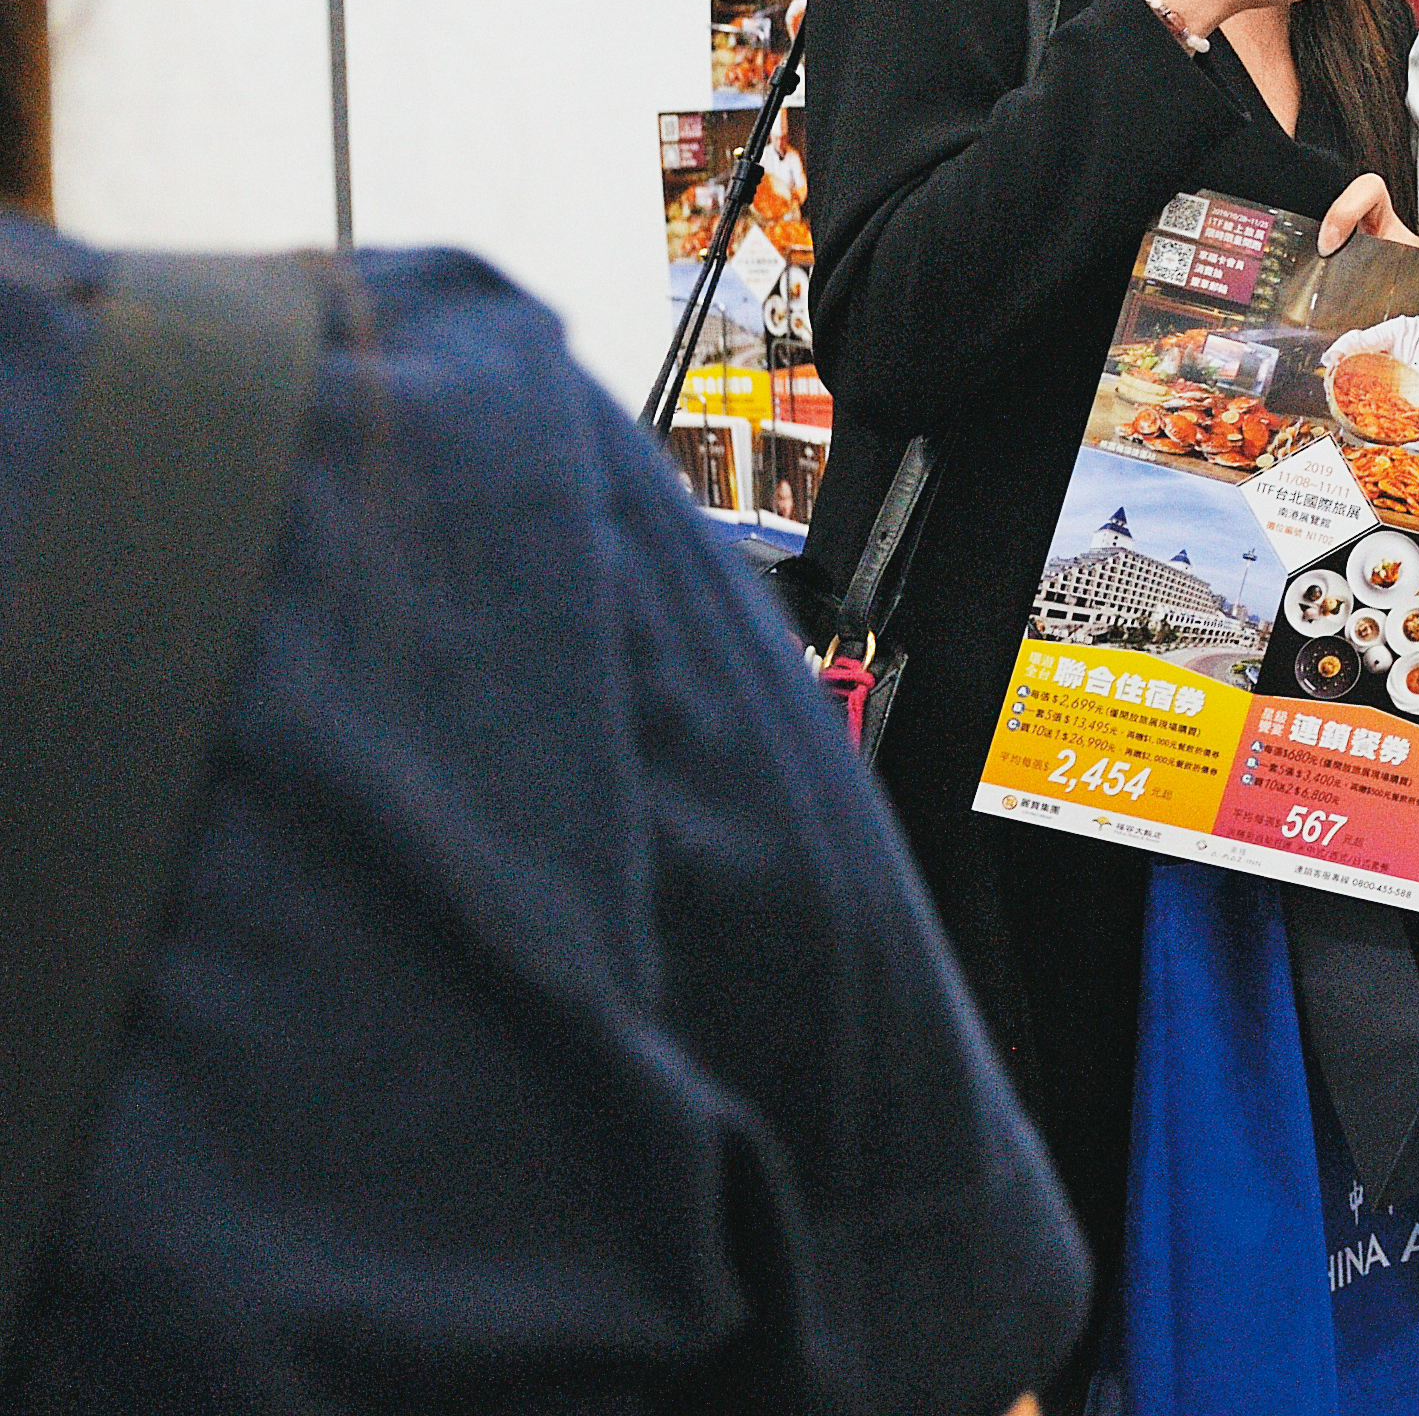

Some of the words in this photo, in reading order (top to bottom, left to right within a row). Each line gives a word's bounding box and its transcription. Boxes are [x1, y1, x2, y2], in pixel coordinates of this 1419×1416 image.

[1278, 471, 1350, 498] 11/08~11/11
[1304, 460, 1333, 477] 2019
[1256, 482, 1361, 520] ITF台北國際旅展
[1306, 531, 1334, 545] N1702
[1052, 655, 1206, 717] 聯合住宿券
[1288, 713, 1411, 766] 連鎖餐券
[1048, 748, 1152, 802] 2,454
[1281, 804, 1348, 847] 567
[1352, 878, 1412, 899] 0800-455-588
